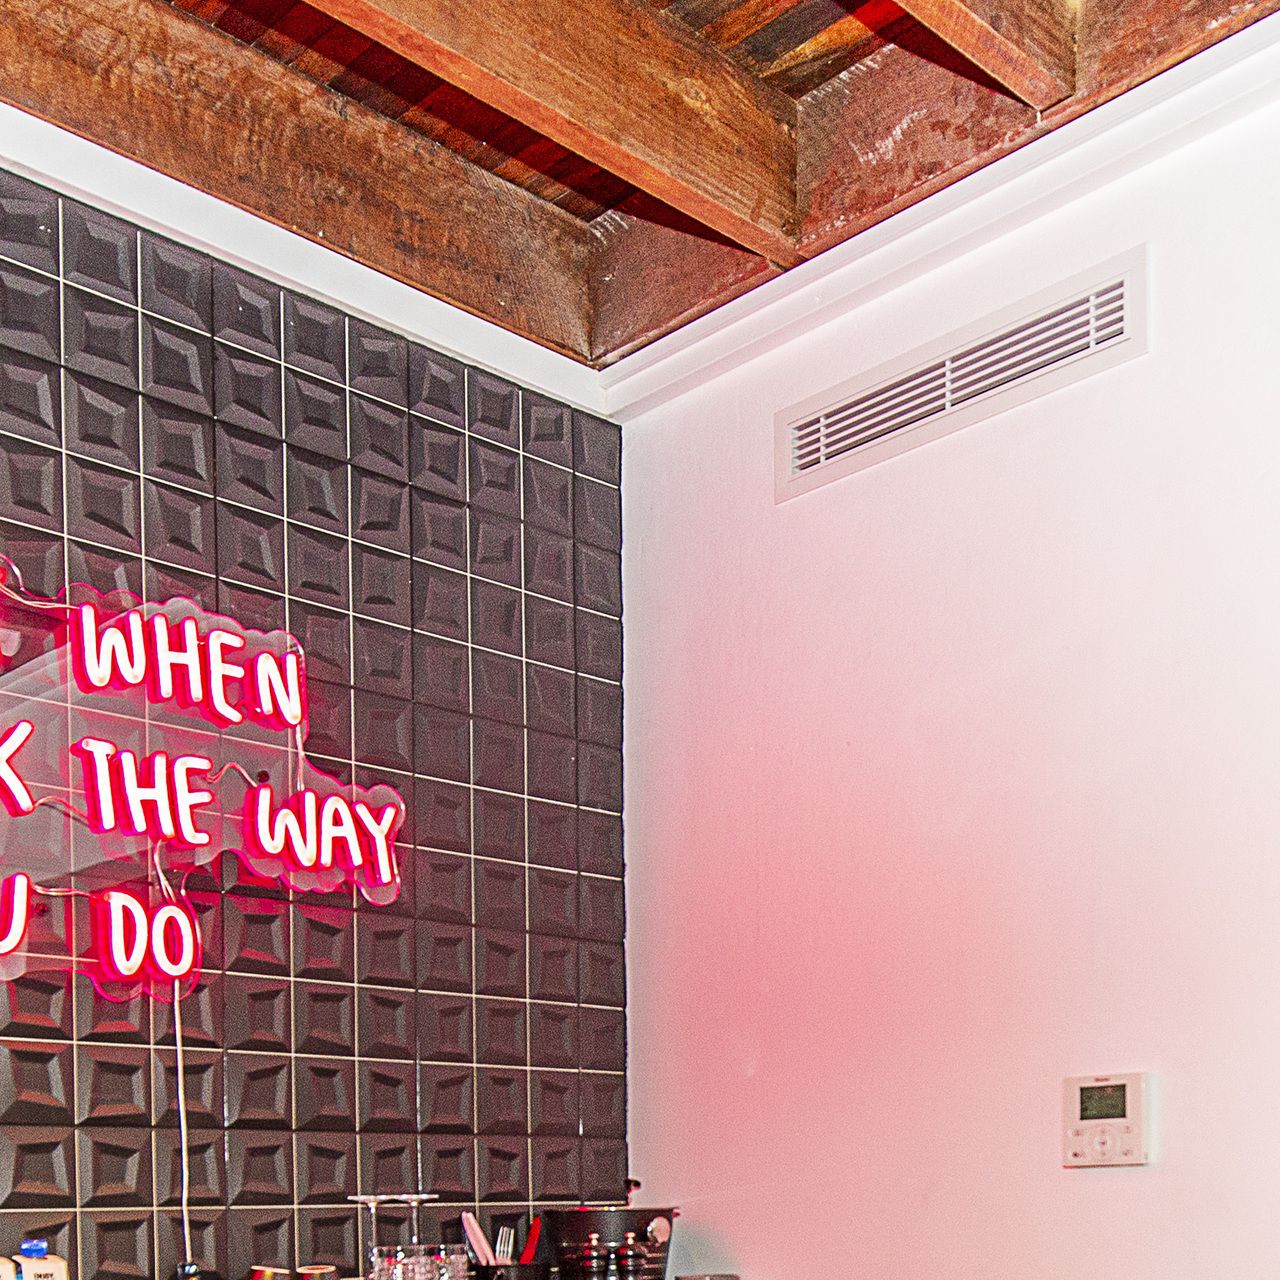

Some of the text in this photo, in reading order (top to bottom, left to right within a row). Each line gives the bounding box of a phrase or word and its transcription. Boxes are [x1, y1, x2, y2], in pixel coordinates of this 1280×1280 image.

[72, 602, 303, 728] WHEN
[76, 739, 214, 846] THE
[256, 786, 400, 887] WAY
[104, 893, 197, 977] DO
